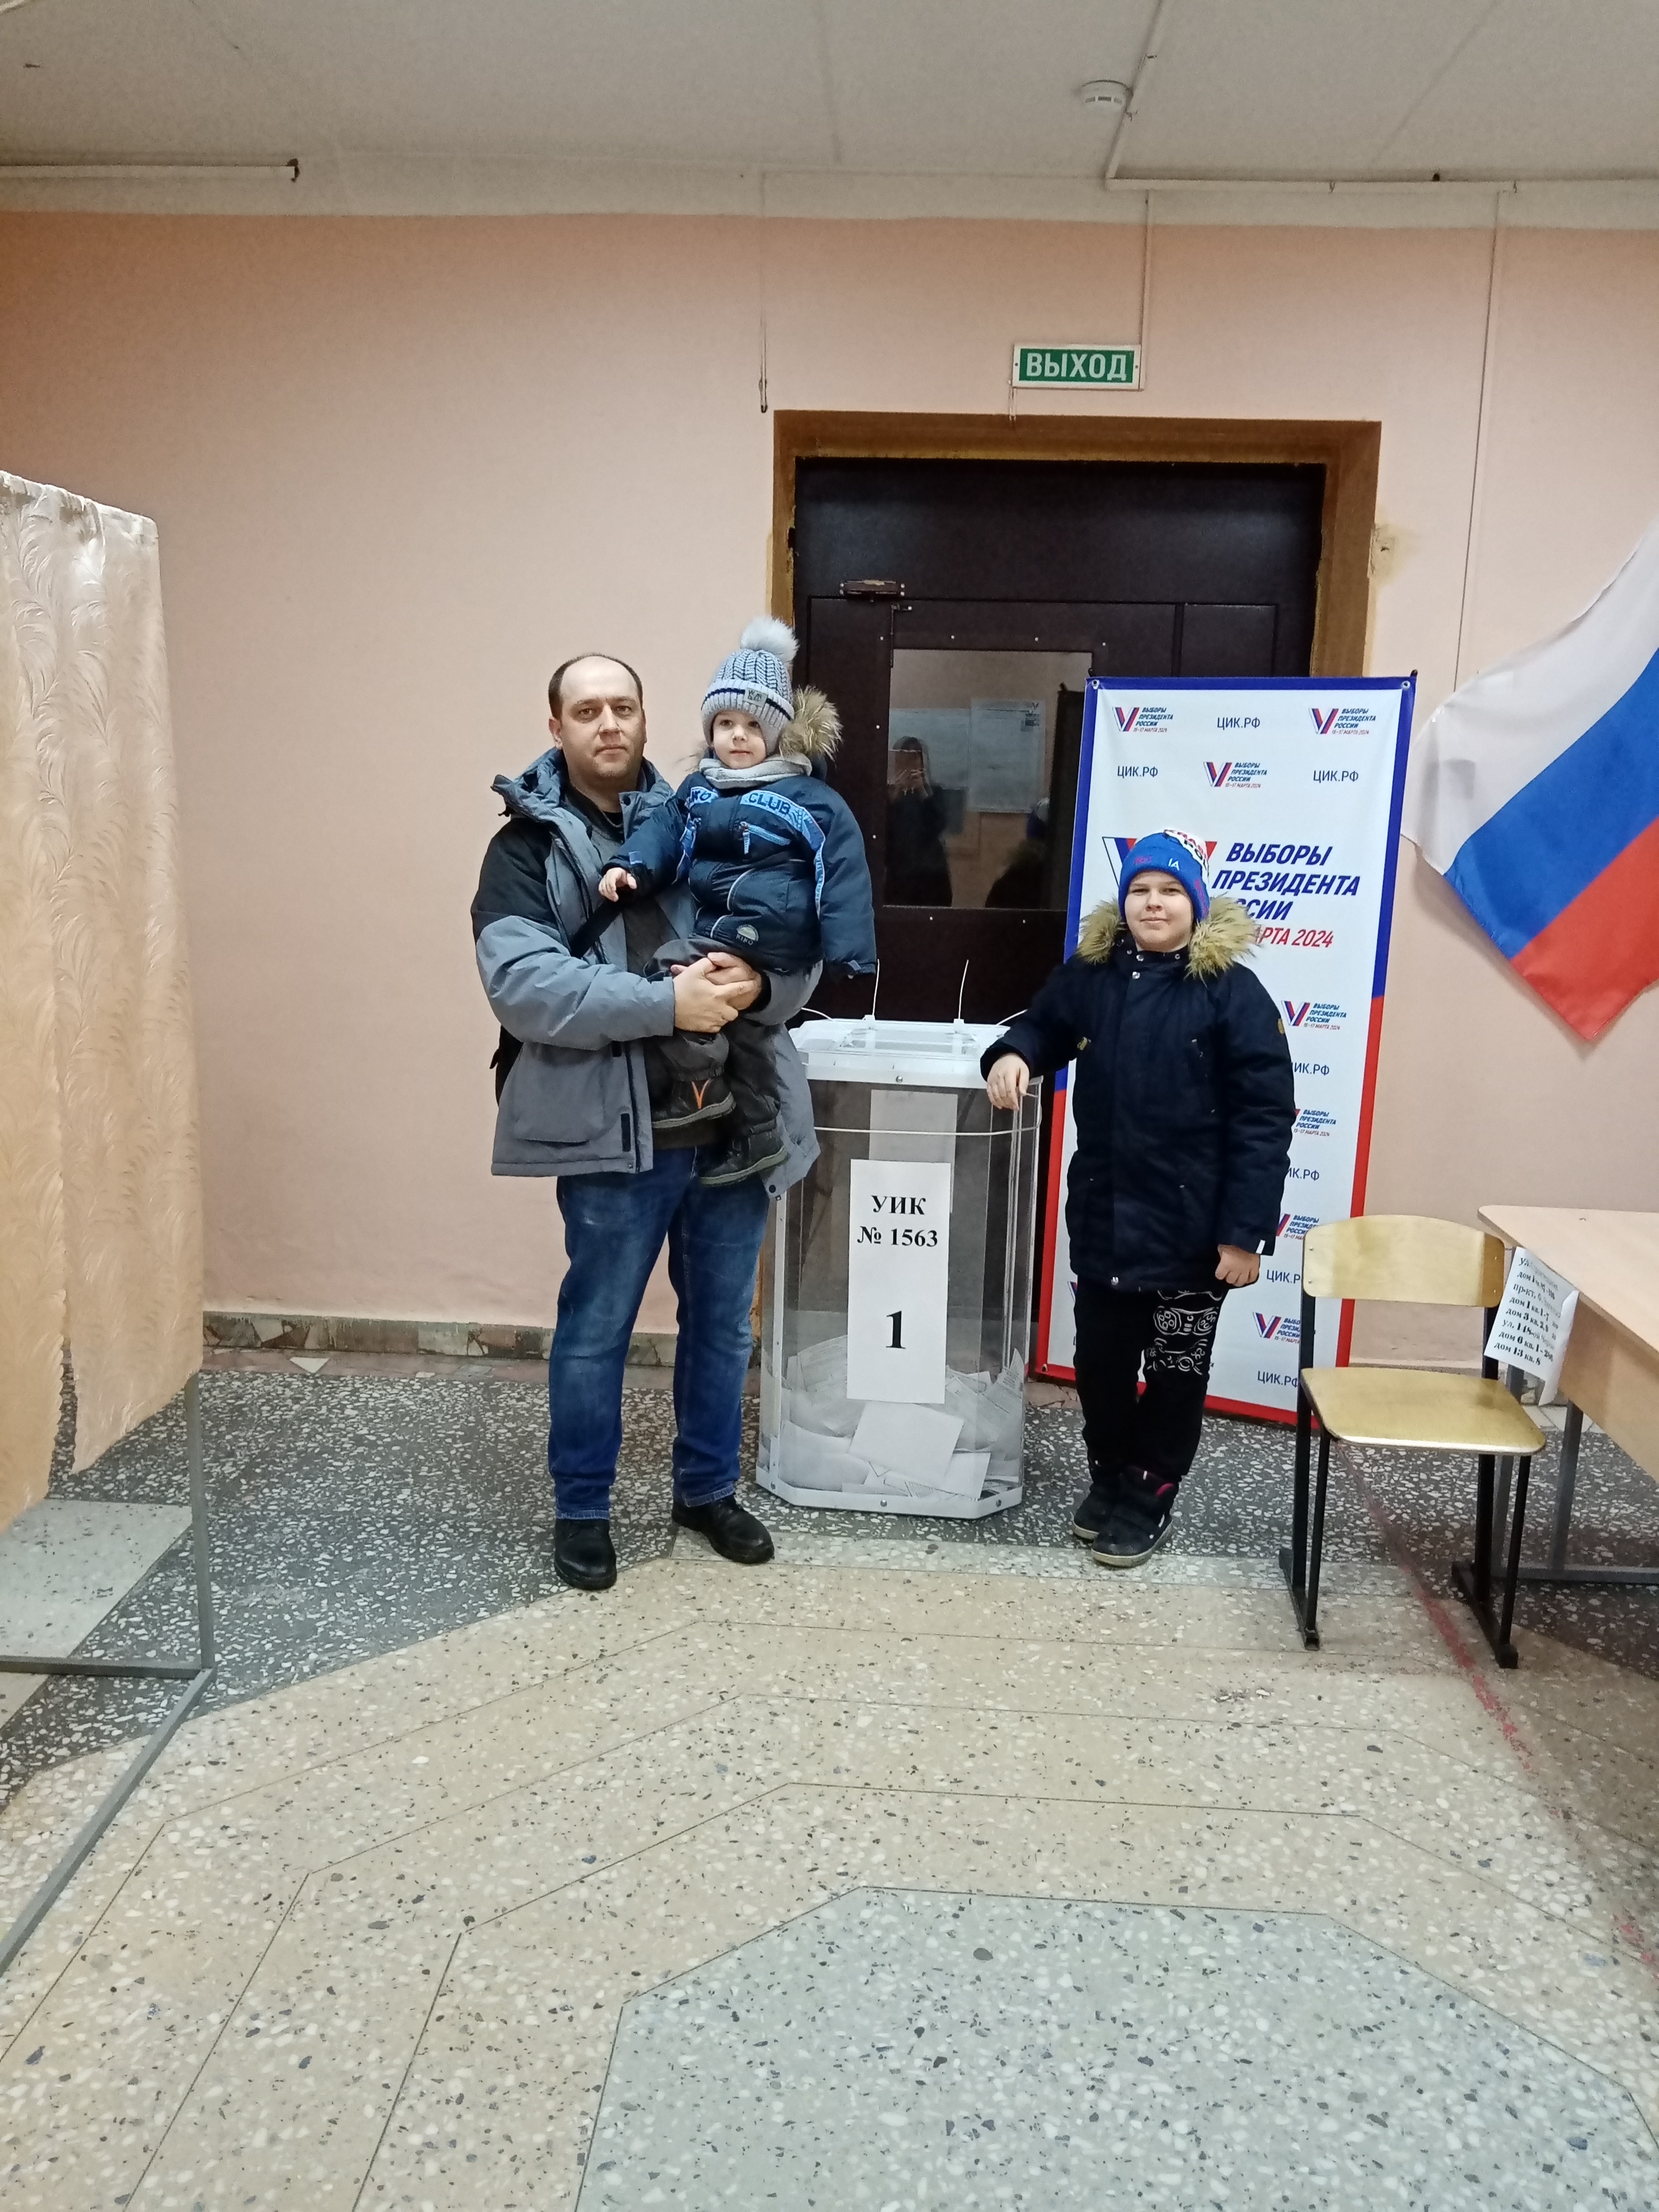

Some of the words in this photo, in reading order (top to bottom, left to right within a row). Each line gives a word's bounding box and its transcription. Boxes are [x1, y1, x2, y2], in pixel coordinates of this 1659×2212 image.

[1026, 353, 1127, 381] ВЫХОД
[1217, 717, 1260, 730] ЦИК.РФ
[1117, 766, 1158, 778] ЦИК.РФ
[1313, 770, 1359, 783] ЦИК.РФ
[748, 792, 792, 815] CLUB
[1225, 842, 1334, 866] ВЫБОРЫ
[1211, 870, 1361, 896] ПРЕЗИДЕНТА
[1237, 899, 1294, 920] СИИ
[736, 933, 754, 945] KIKO
[1292, 929, 1334, 948] 2024
[1291, 1062, 1330, 1076] ИК.РФ
[1299, 1116, 1336, 1125] ПРЕЗИДЕНТА
[871, 1195, 926, 1215] УИК
[857, 1226, 882, 1244] №
[891, 1228, 938, 1247] 1563
[1267, 1269, 1301, 1284] ЦИК.Р
[1517, 1271, 1531, 1281] дом
[1510, 1297, 1524, 1306] дом
[1502, 1319, 1514, 1328] ул.
[1506, 1309, 1522, 1318] дом
[1530, 1318, 1539, 1326] кв.
[886, 1311, 906, 1350] 1
[1498, 1331, 1515, 1341] дом
[1524, 1341, 1534, 1350] кв.
[1494, 1343, 1511, 1353] дом
[1513, 1347, 1523, 1357] 13
[1524, 1354, 1535, 1363] кв.
[1536, 1357, 1540, 1365] 8
